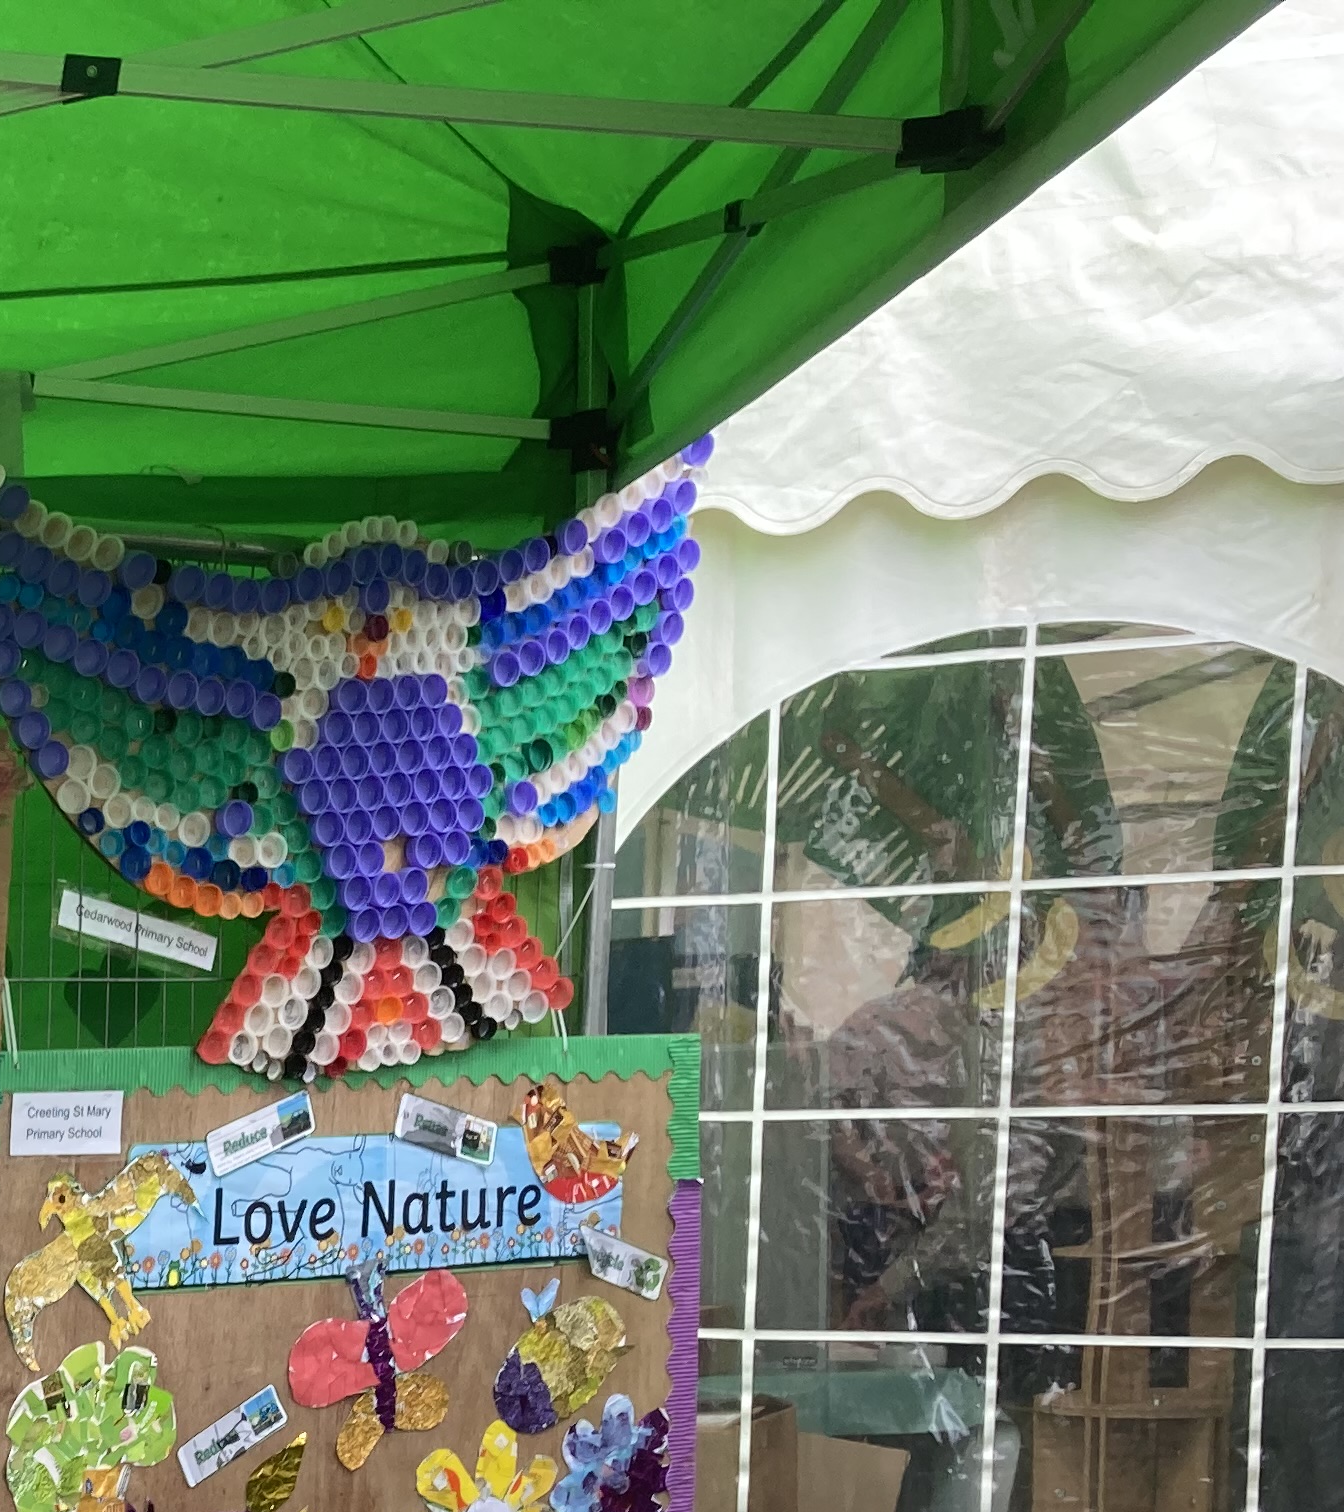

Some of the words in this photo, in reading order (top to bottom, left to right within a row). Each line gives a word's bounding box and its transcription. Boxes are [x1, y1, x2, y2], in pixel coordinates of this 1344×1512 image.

[75, 904, 133, 933] Cedarwood
[135, 923, 175, 950] Primary
[176, 936, 209, 958] School
[27, 1106, 71, 1121] Creeting
[73, 1105, 84, 1118] St
[87, 1105, 112, 1120] Mary
[26, 1128, 65, 1143] Primary
[67, 1127, 102, 1140] School
[222, 1126, 268, 1156] Reduce
[213, 1187, 335, 1247] Love
[360, 1179, 543, 1238] Nature
